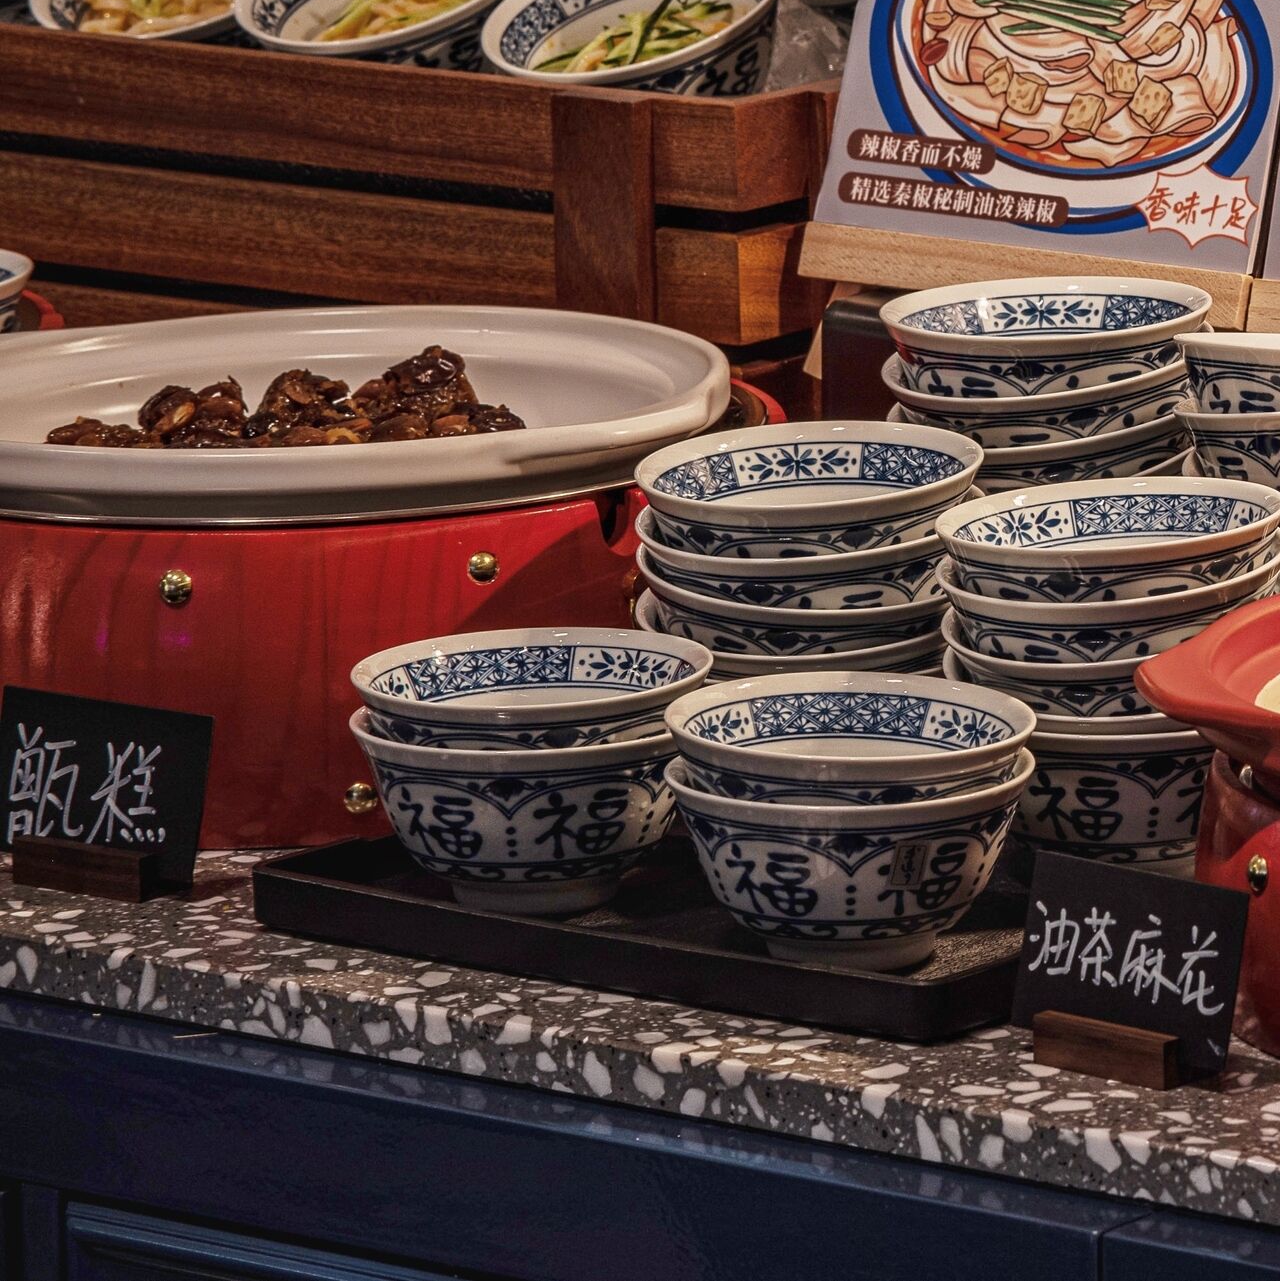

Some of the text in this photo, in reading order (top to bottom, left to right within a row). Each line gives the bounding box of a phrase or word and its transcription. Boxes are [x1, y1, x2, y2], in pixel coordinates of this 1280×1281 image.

[859, 133, 983, 170] 辣椒香而不燥
[850, 176, 1058, 223] 精选秦椒秘制油泼辣椒
[1145, 187, 1247, 230] 香味十足
[398, 786, 484, 859] 福
[533, 789, 629, 859] 福
[1028, 770, 1124, 842] 福
[726, 843, 819, 918] 福
[1028, 900, 1226, 1016] 油茶麻花
